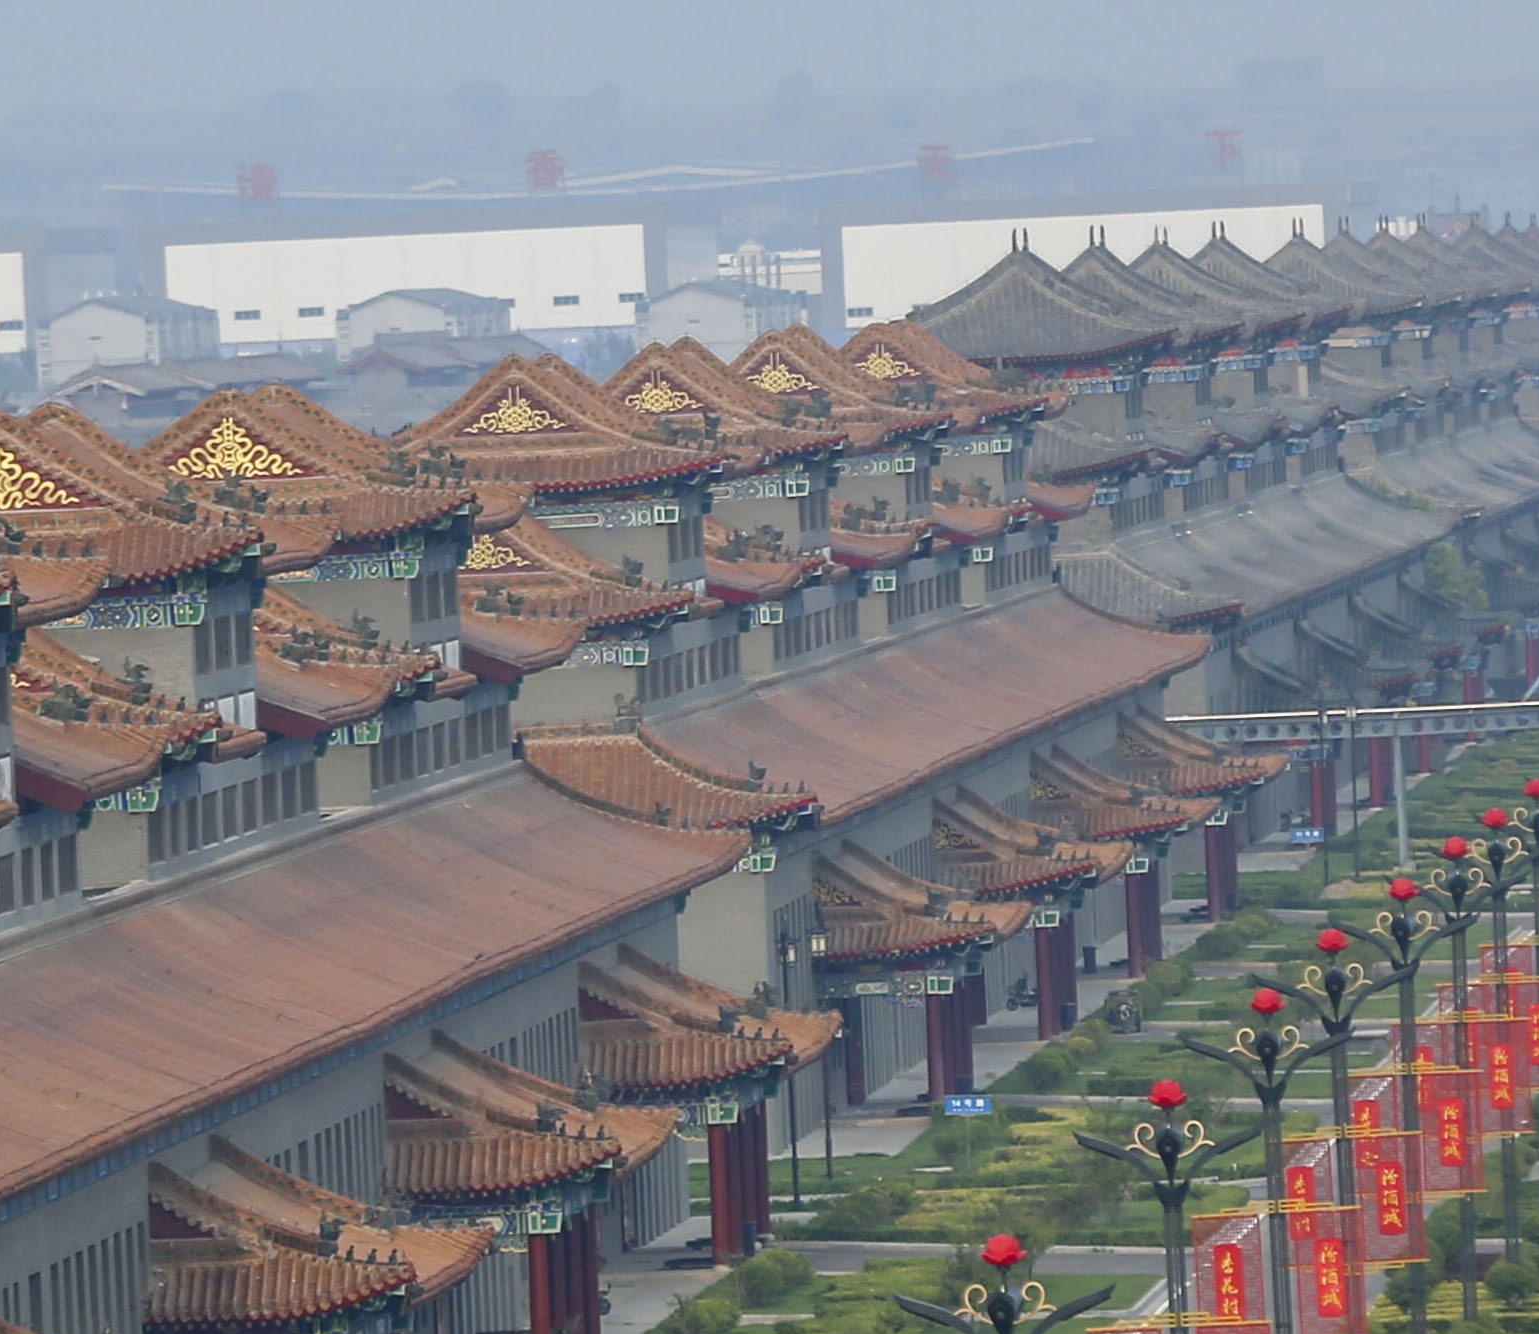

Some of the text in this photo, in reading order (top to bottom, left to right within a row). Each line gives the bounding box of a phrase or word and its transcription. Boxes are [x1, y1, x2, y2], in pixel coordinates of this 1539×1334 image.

[1494, 1048, 1512, 1102] 汾酒城
[1444, 1105, 1462, 1160] 汾酒城
[1382, 1168, 1403, 1228] 汾酒城
[1321, 1245, 1343, 1310] 汾酒城
